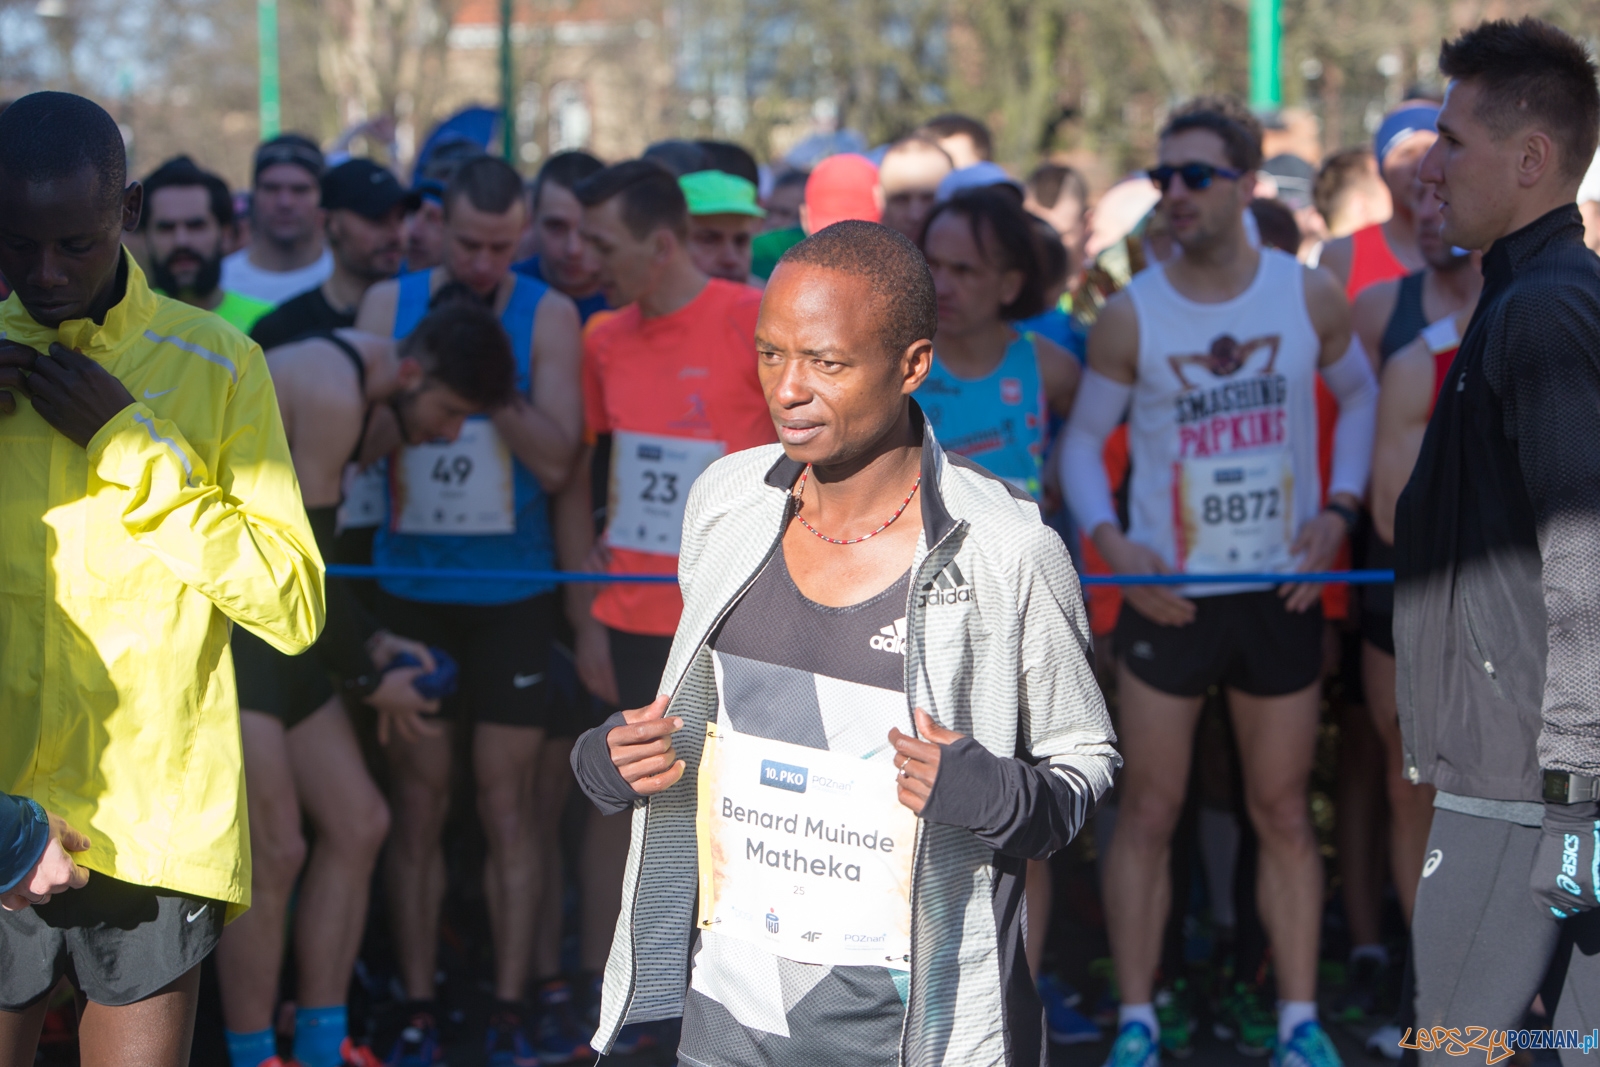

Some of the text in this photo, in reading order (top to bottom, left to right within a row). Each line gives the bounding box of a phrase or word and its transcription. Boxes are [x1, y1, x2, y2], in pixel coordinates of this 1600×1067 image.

[1175, 374, 1287, 424] SMASHING
[1179, 407, 1286, 459] PAPKINS
[430, 455, 473, 485] 49
[641, 470, 678, 504] 23
[1203, 488, 1279, 525] 8872
[779, 769, 804, 786] PKO
[722, 797, 895, 853] Benard Muinde
[745, 837, 862, 882] Matheka
[1561, 833, 1580, 877] asics
[793, 885, 805, 896] 25
